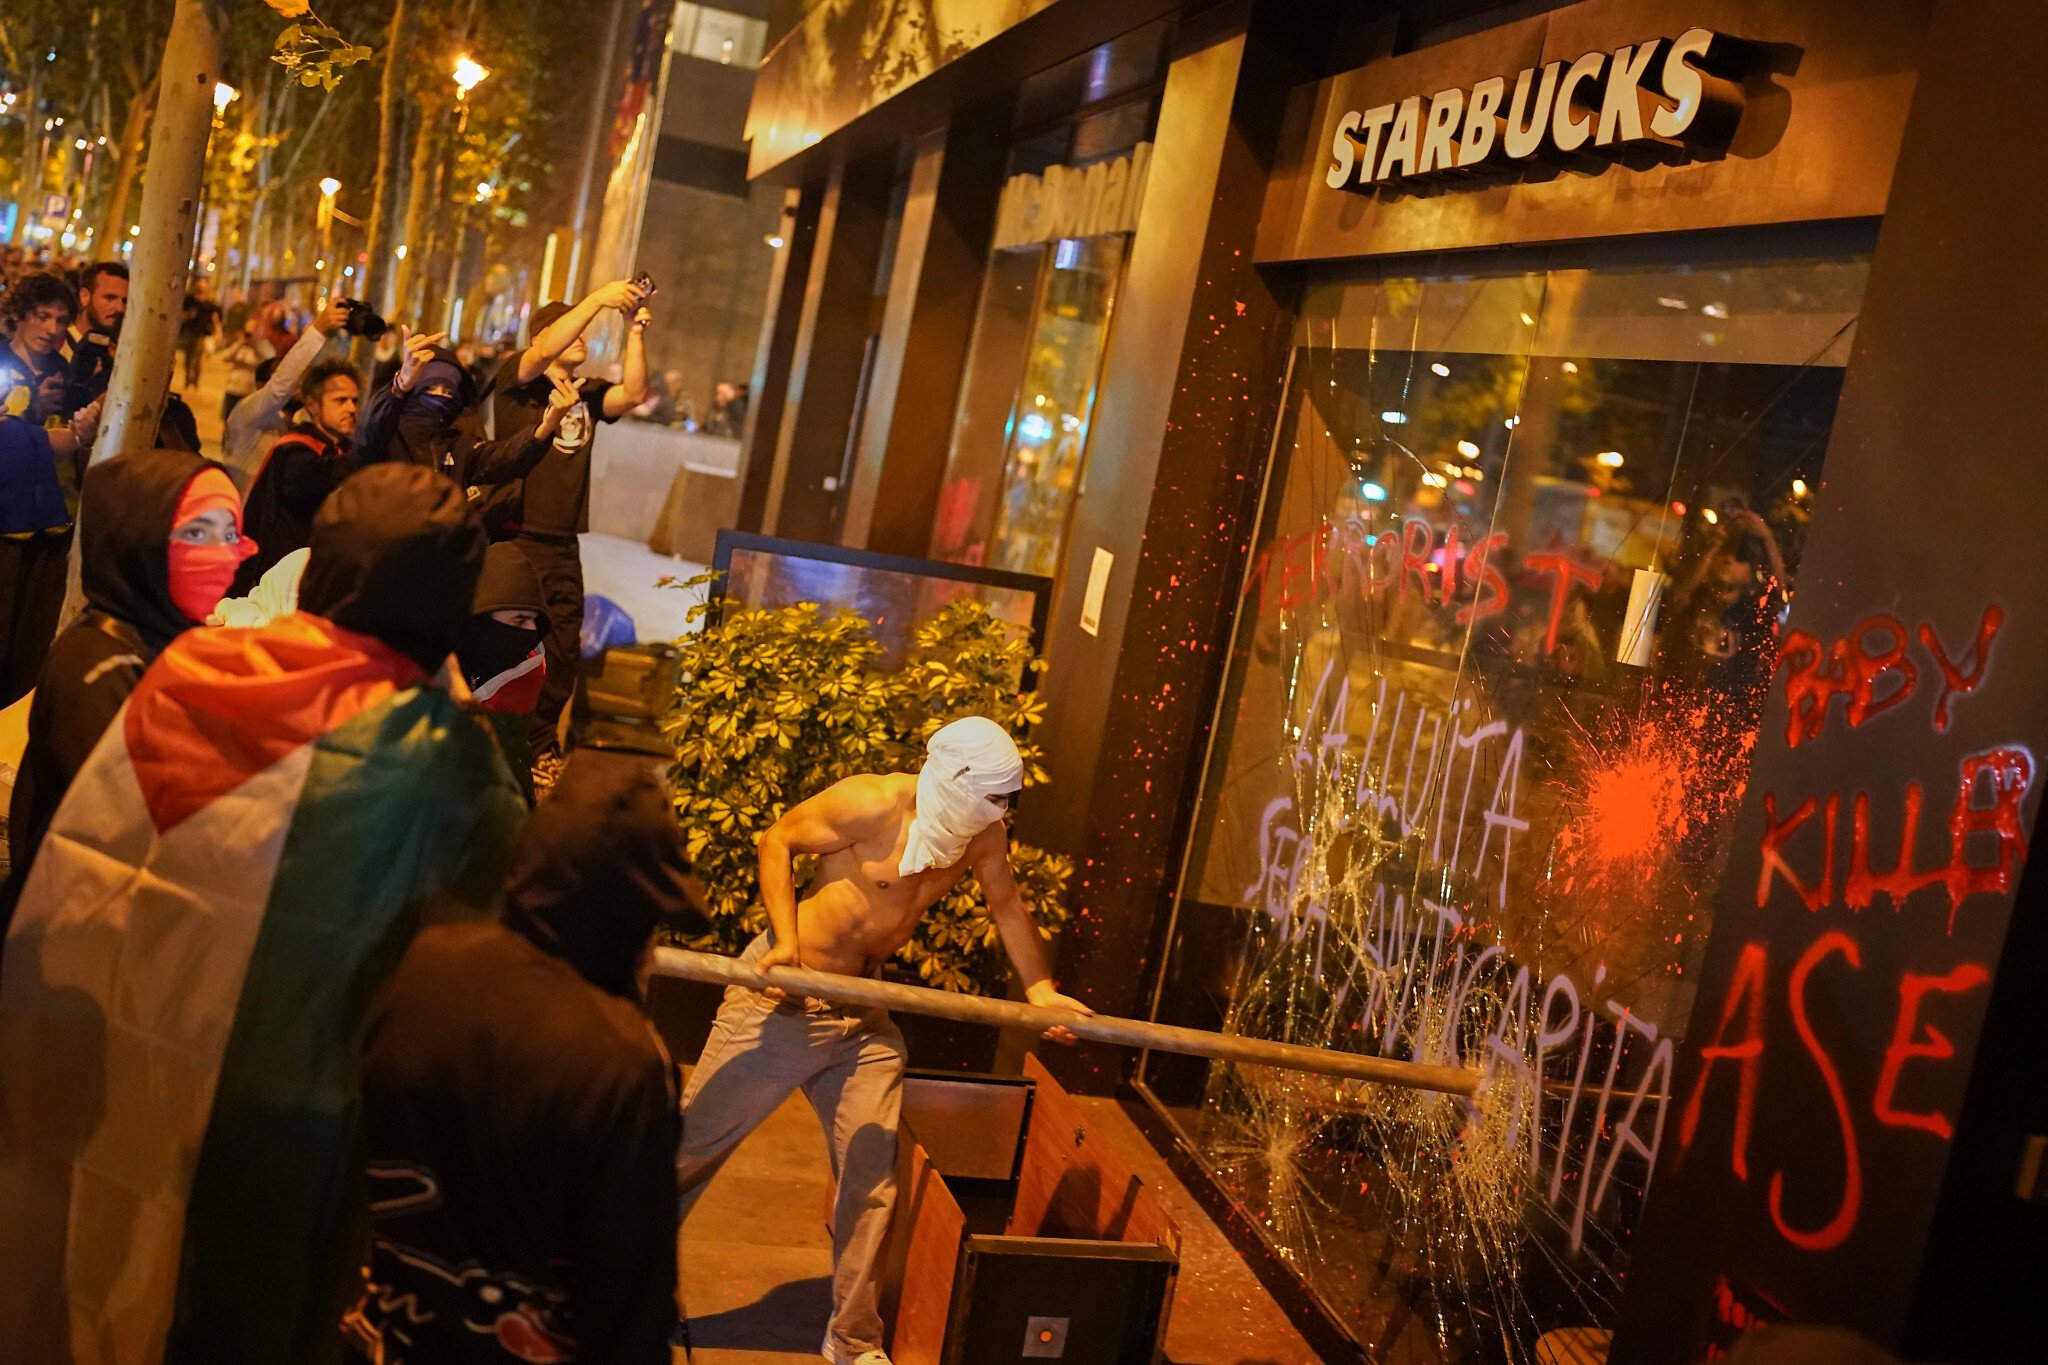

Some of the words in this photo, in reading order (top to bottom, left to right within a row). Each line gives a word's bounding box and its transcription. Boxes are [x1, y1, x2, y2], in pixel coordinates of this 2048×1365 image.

[1326, 26, 1715, 189] STARBUCKS
[1776, 604, 2004, 748] BABY
[1675, 931, 1990, 1251] ASE
